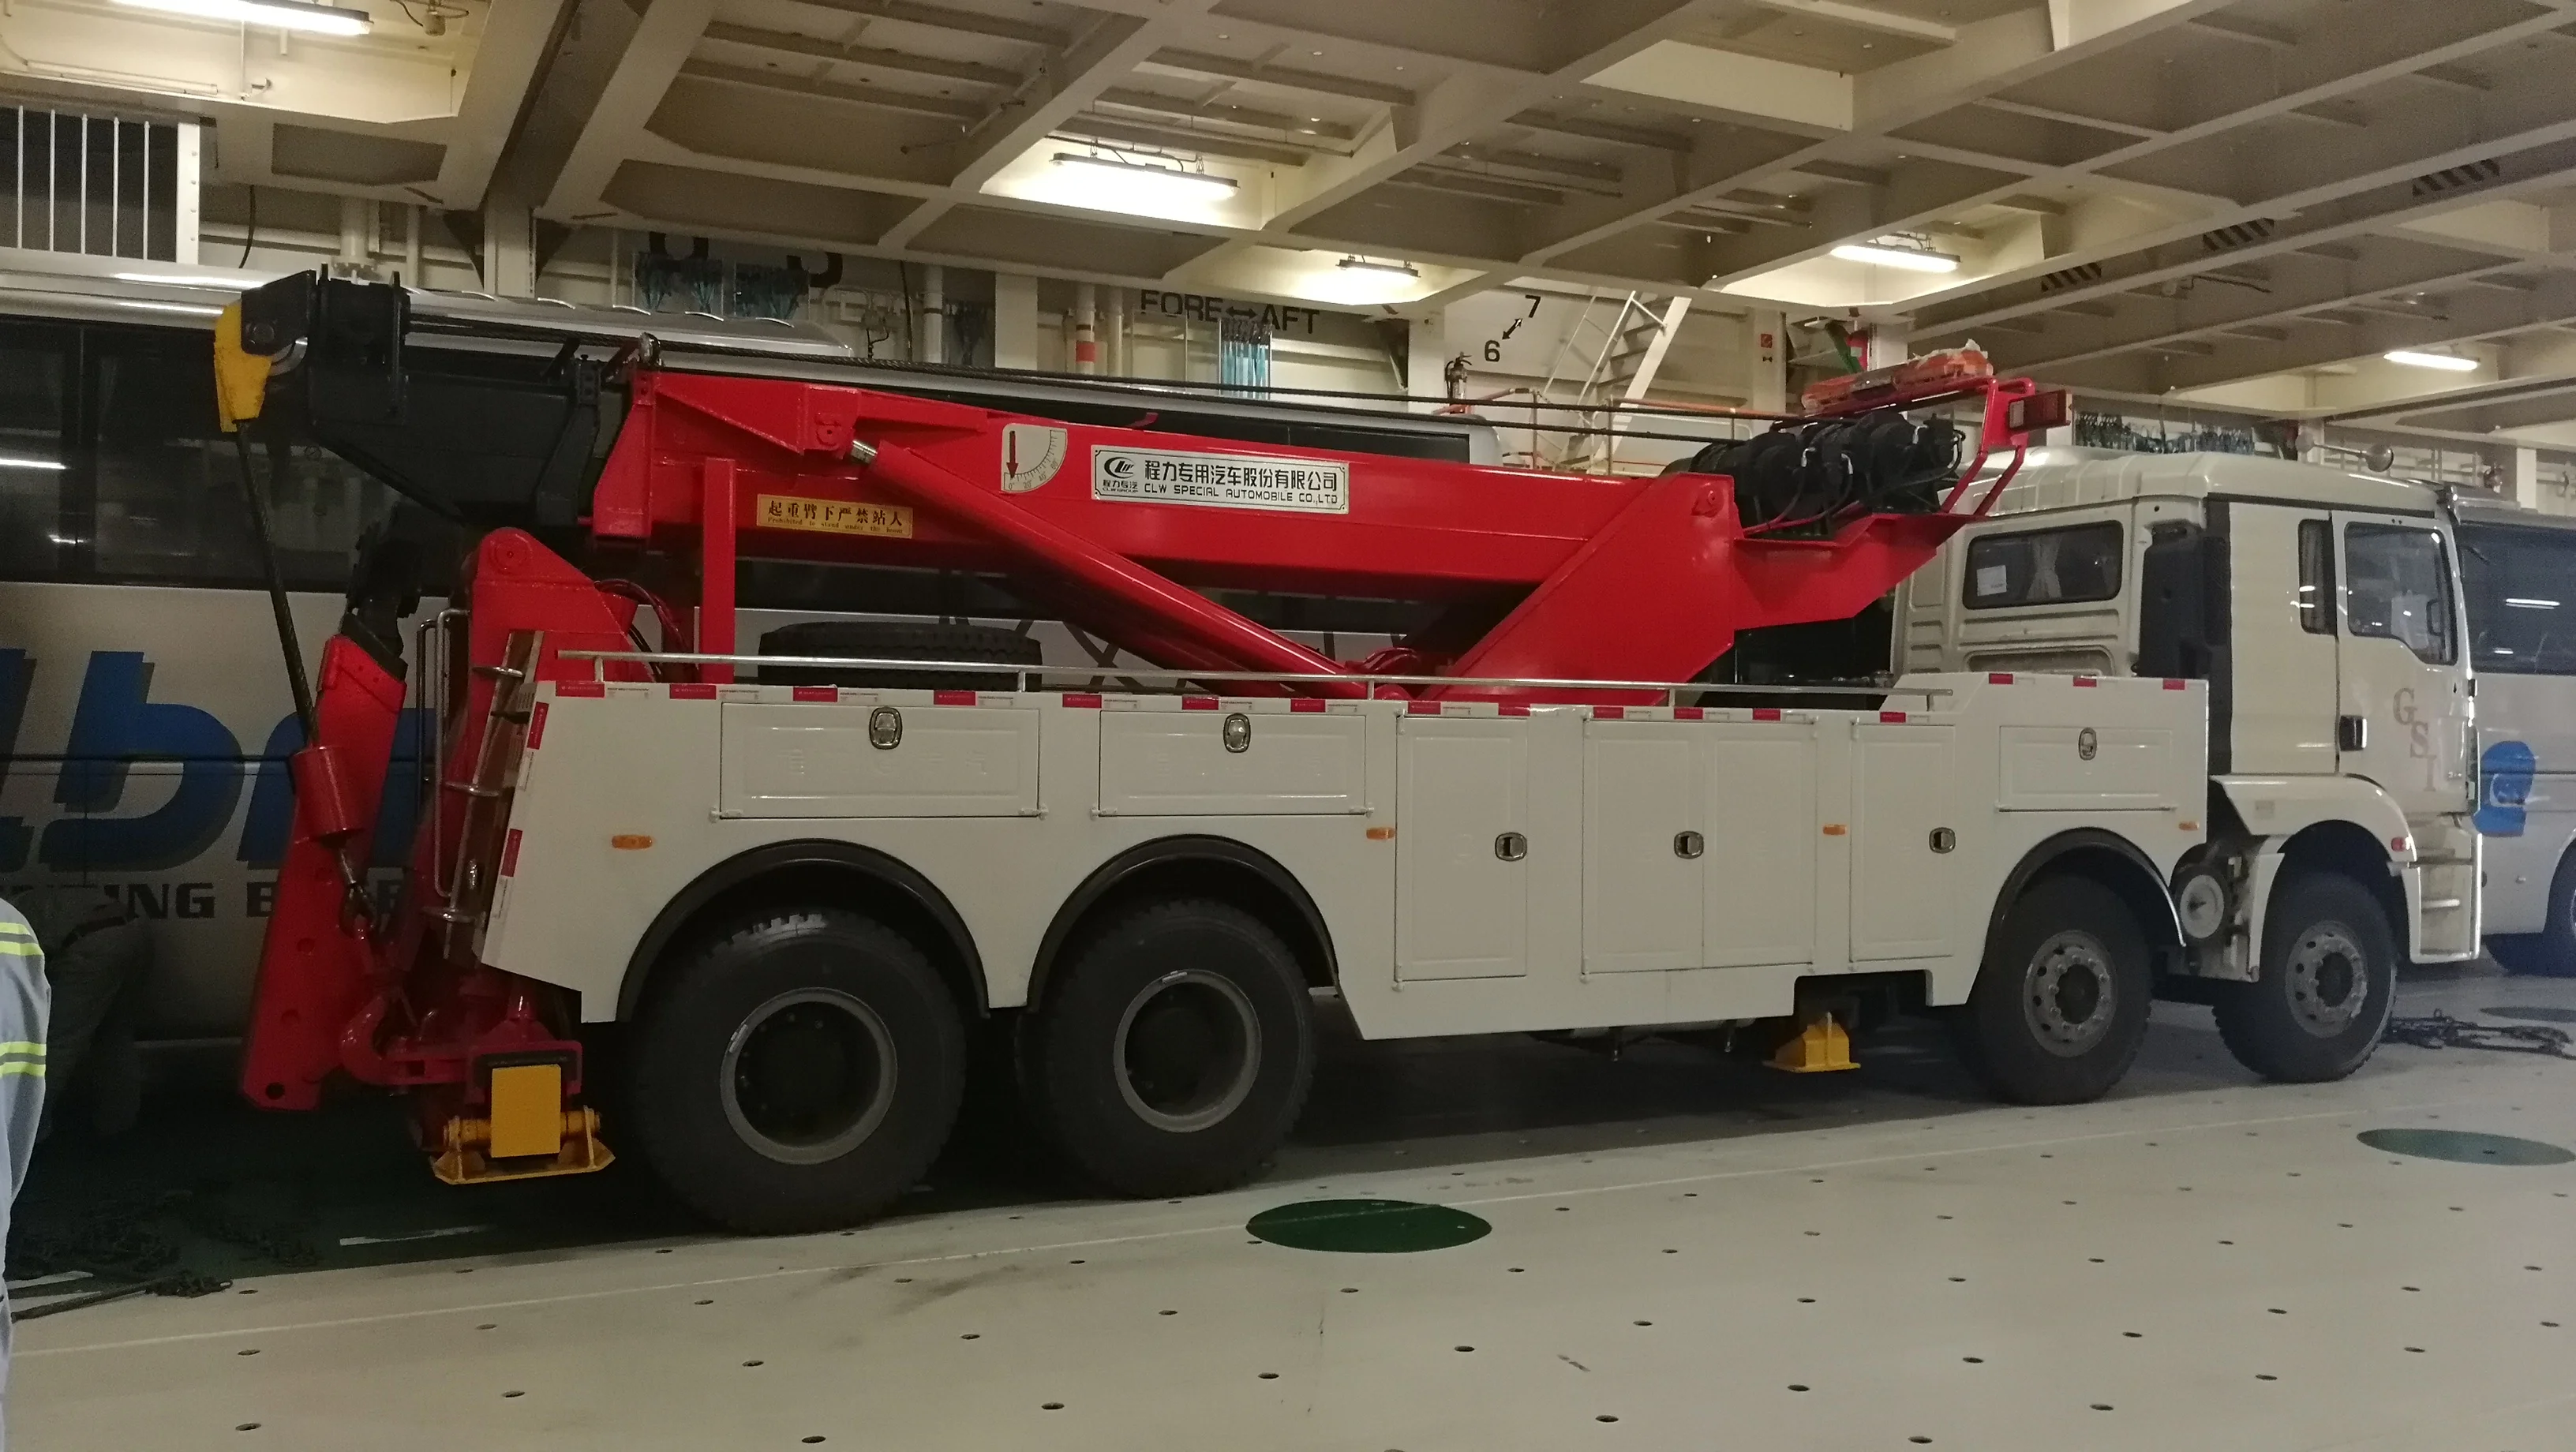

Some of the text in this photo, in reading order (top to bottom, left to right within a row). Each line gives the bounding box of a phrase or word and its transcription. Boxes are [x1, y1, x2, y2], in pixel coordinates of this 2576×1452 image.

[1140, 289, 1320, 334] FORE AFT
[1524, 294, 1541, 319] 7
[1484, 339, 1500, 362] 6
[1144, 460, 1337, 492] 程力专用汽车股份有限公司
[1144, 483, 1167, 493] CLW
[1174, 485, 1219, 497] SPECIAL
[1226, 488, 1293, 502] AUTOMOBILE
[768, 500, 903, 527] 起重臂下严禁站人
